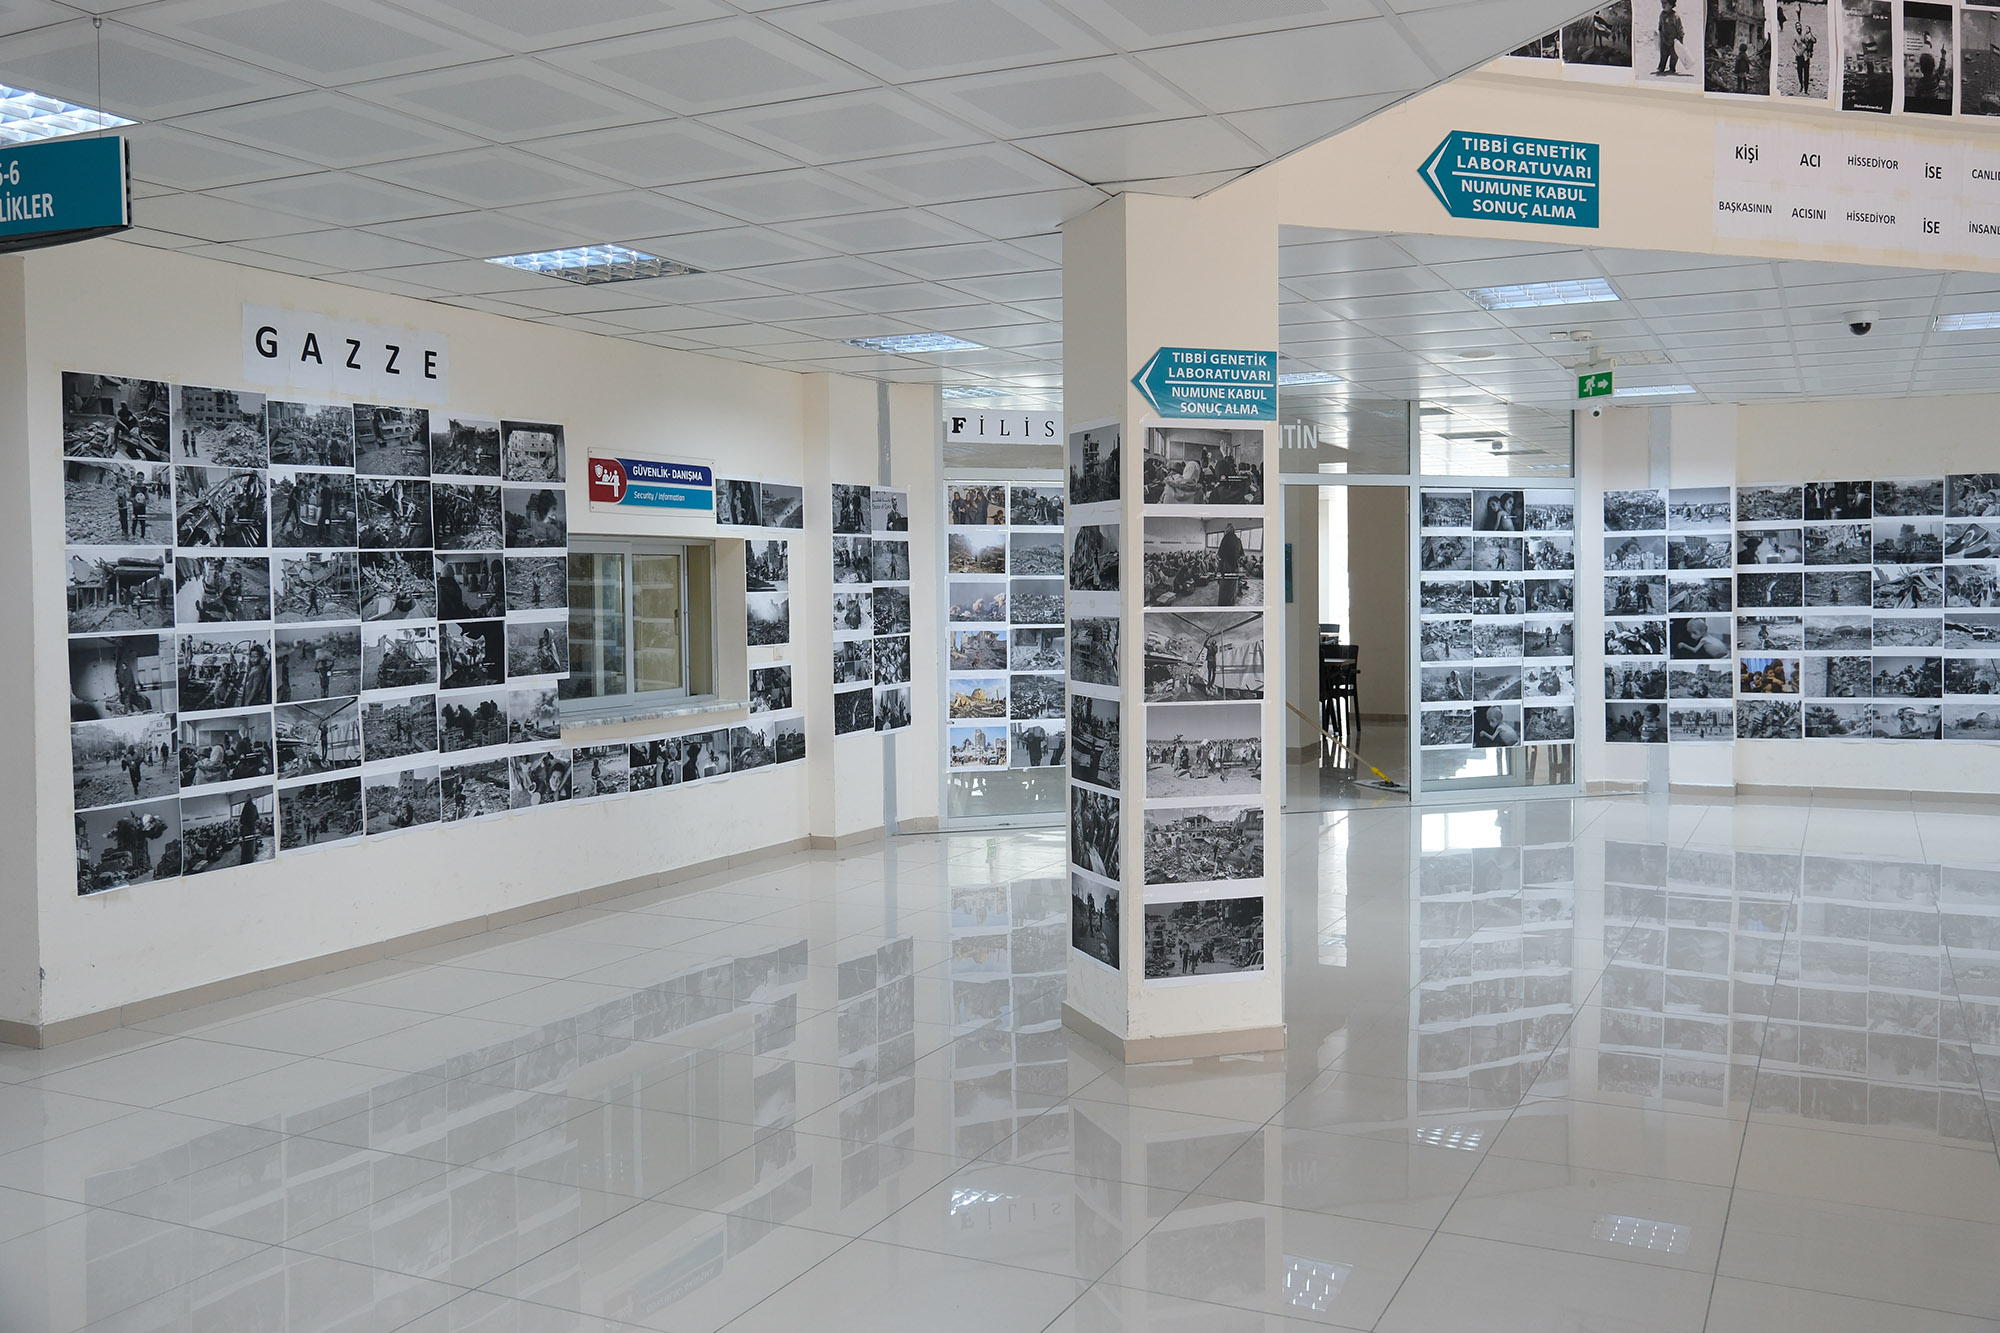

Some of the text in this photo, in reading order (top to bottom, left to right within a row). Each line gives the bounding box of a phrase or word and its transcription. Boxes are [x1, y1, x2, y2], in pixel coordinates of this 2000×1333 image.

[1461, 137, 1587, 161] TIBBİ GENETİK
[1456, 155, 1592, 179] LABORATUVARI
[1735, 143, 1759, 164] KİŞİ
[1800, 153, 1821, 168] ACI
[1847, 155, 1899, 170] HİSSEDİYOR
[1924, 162, 1942, 180] İSE
[1461, 179, 1588, 202] NUMUNE KABUL
[1472, 199, 1577, 220] SONUÇ ALMA
[1718, 201, 1773, 214] BAŞKASININ
[1791, 207, 1827, 220] ACISINI
[1846, 211, 1896, 225] HİSSEDİYOR
[1923, 217, 1941, 234] İSE
[255, 325, 438, 380] GAZZE
[1172, 351, 1267, 366] TIBBİ GENETİK
[1168, 367, 1271, 381] LABORATUVARI
[1171, 387, 1267, 400] NUMUNE KABUL
[1180, 402, 1259, 416] SONUÇ ALMA
[1279, 419, 1318, 449] TİN
[672, 469, 703, 482] DANIŞMA
[633, 490, 655, 501] Security
